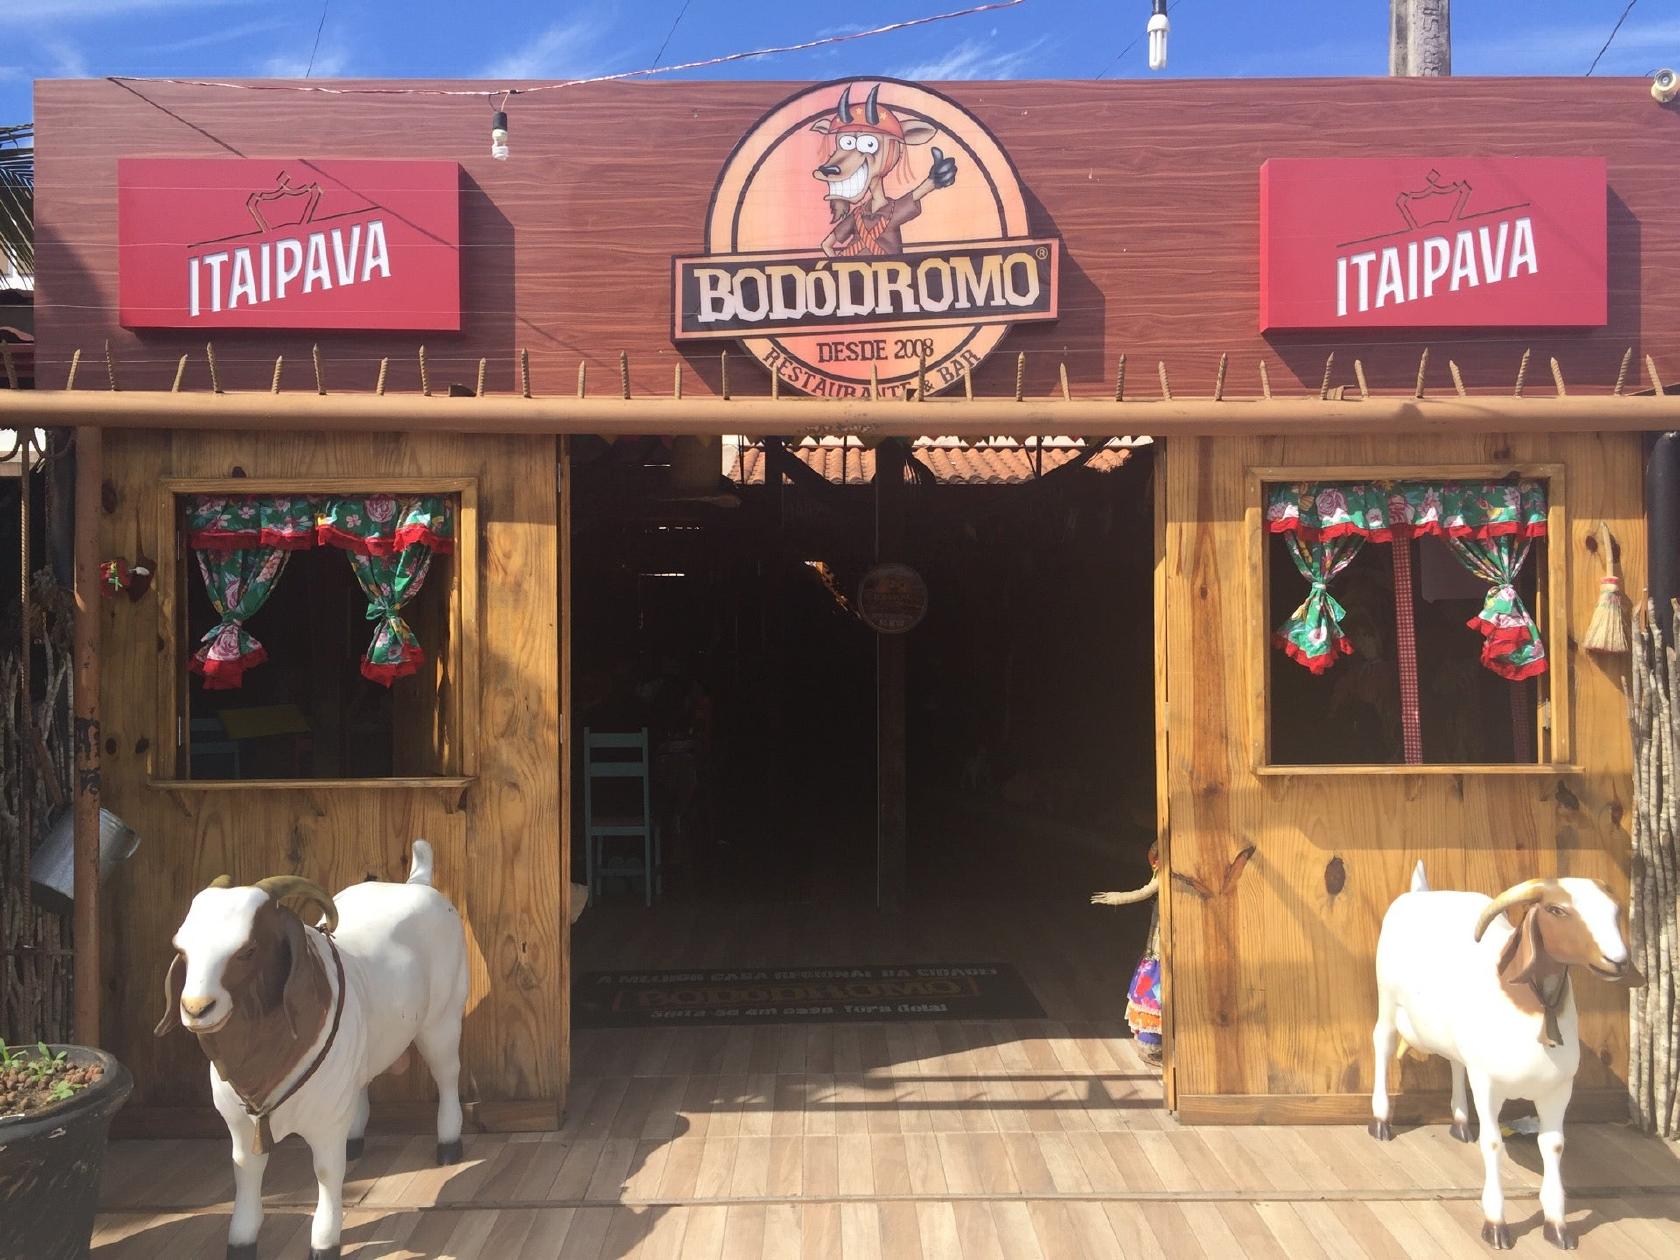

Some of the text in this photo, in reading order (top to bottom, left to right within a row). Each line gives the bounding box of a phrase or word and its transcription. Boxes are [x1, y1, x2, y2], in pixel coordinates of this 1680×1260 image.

[188, 219, 392, 318] ITAIPAVA
[694, 251, 1040, 323] BODÓDROMO
[1336, 217, 1539, 318] ITAIPAVA
[816, 337, 935, 363] DESDE 2008
[936, 349, 982, 385] BAR
